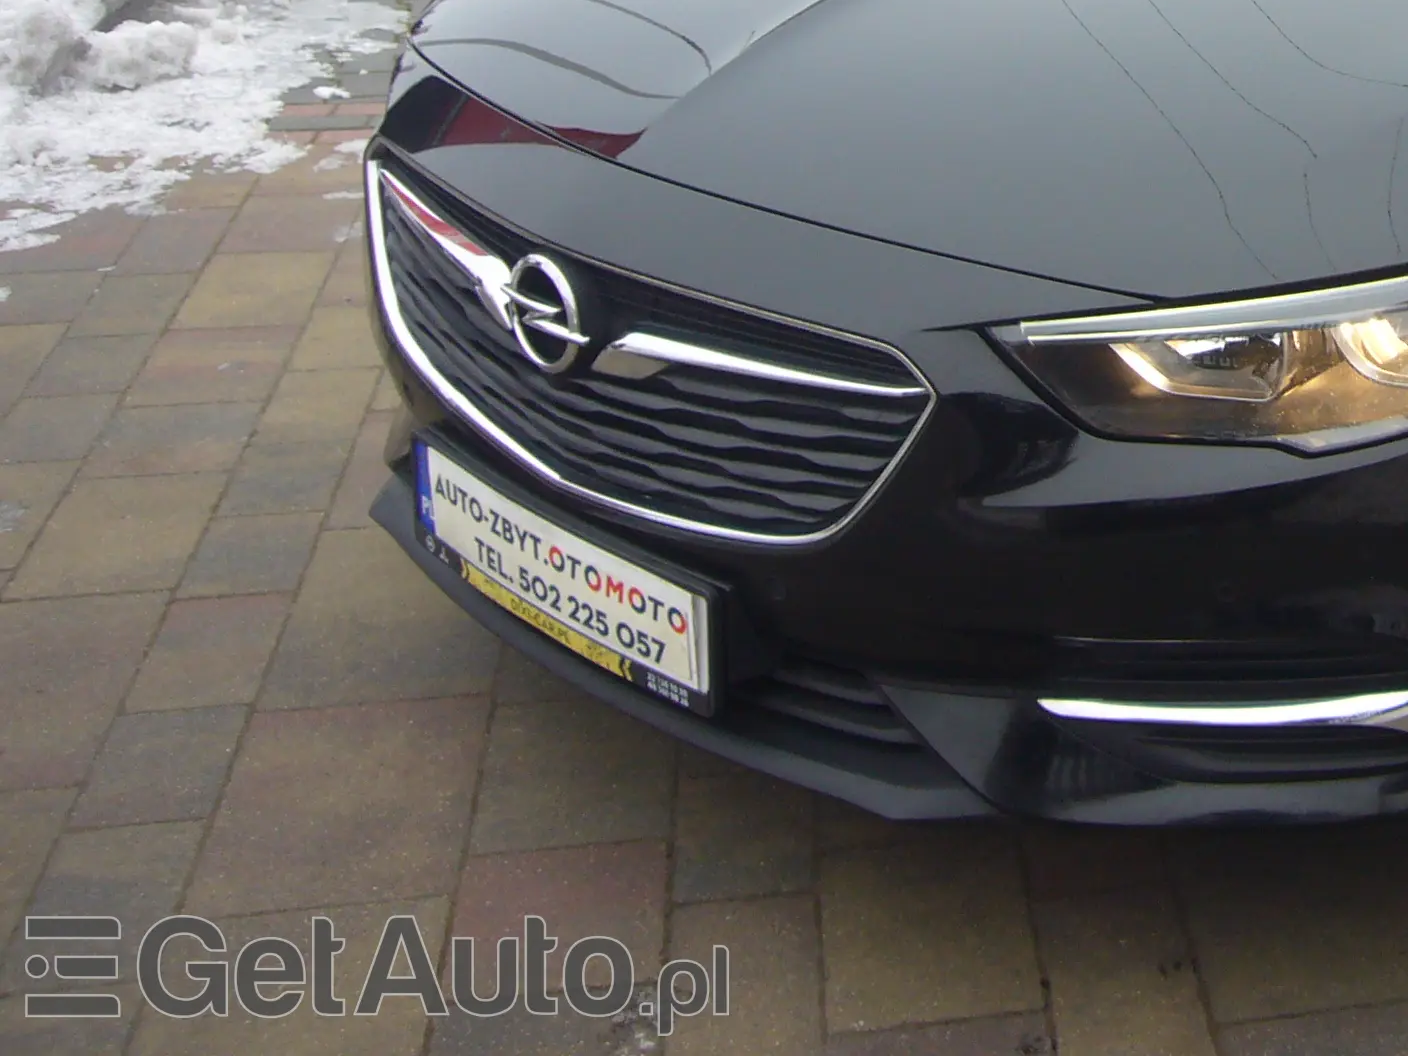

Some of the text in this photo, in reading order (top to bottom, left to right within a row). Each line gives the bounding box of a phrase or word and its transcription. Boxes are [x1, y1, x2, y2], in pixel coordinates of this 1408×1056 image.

[435, 474, 688, 635] AUTO-ZBYT.OTOMOTO
[475, 536, 514, 583] TEL.
[518, 565, 562, 613] 502
[567, 595, 609, 637] 225
[616, 621, 668, 664] 057
